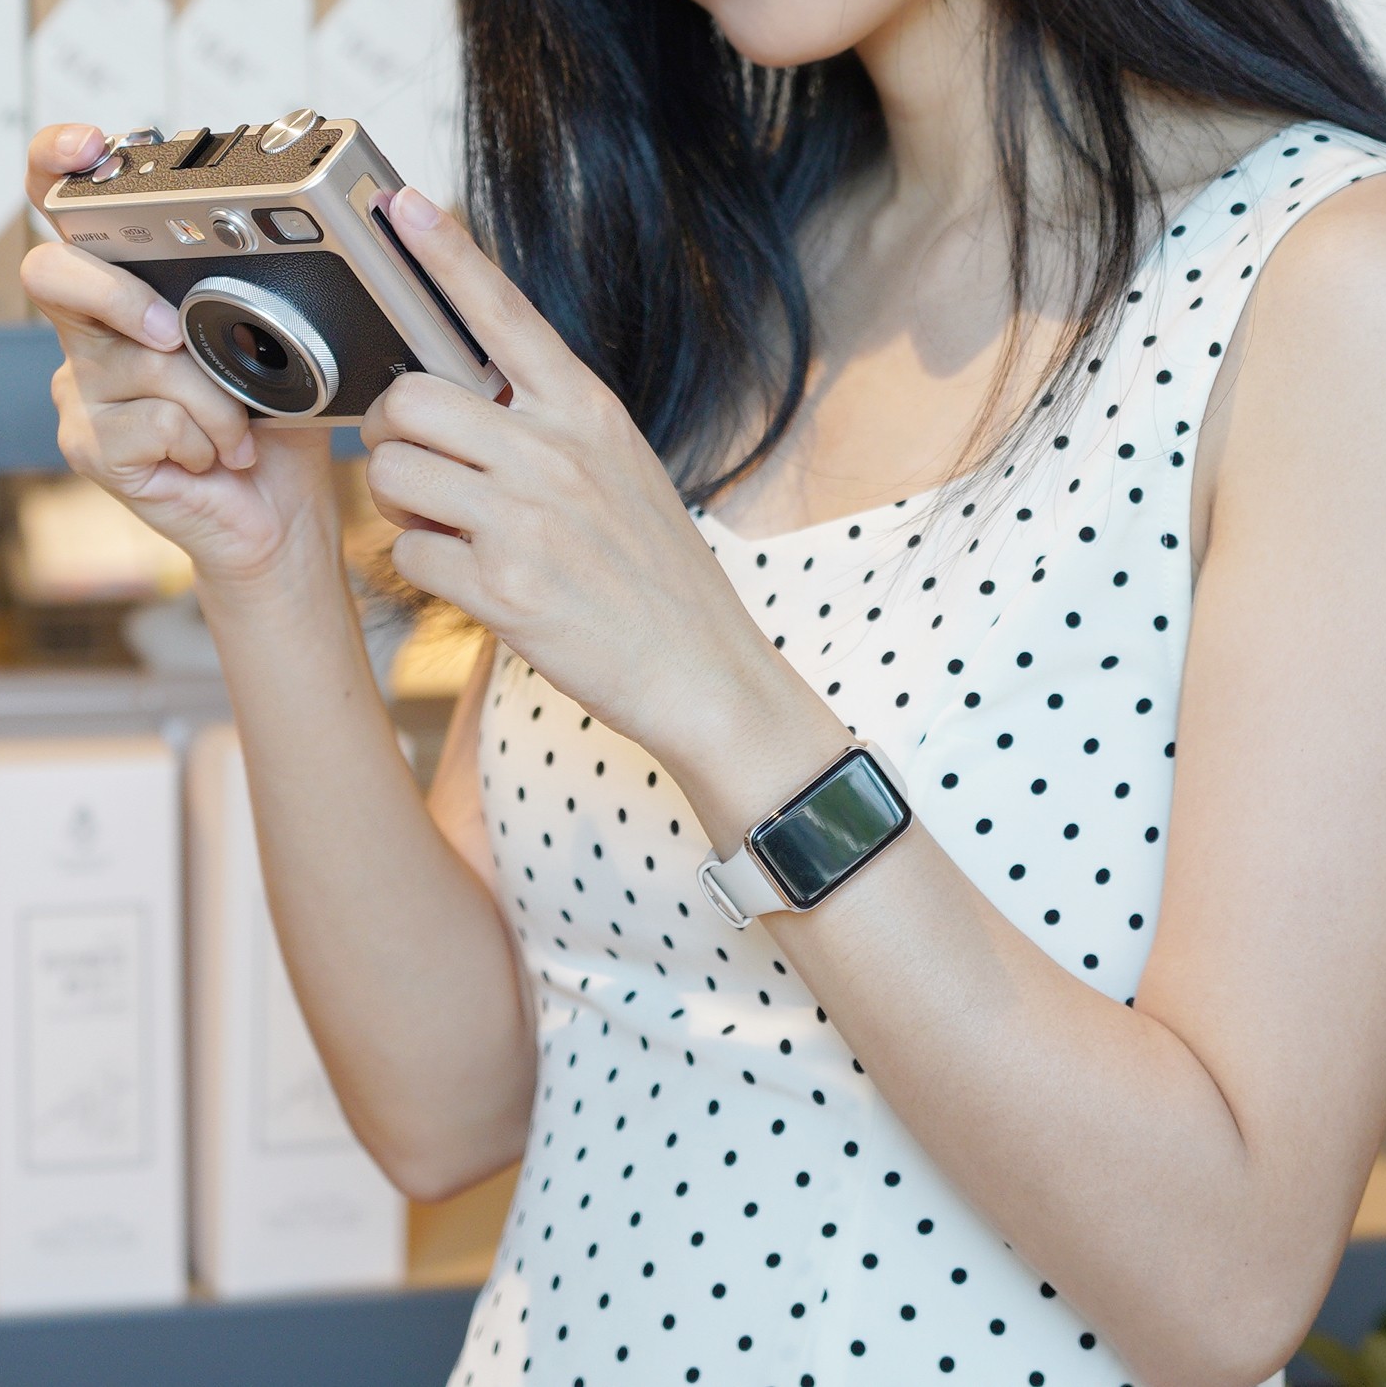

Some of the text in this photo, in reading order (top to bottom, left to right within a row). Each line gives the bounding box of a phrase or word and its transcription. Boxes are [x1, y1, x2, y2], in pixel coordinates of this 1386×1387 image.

[71, 232, 111, 242] FUJIFILM
[203, 347, 226, 370] RANGE
[224, 369, 248, 389] FOCUS
